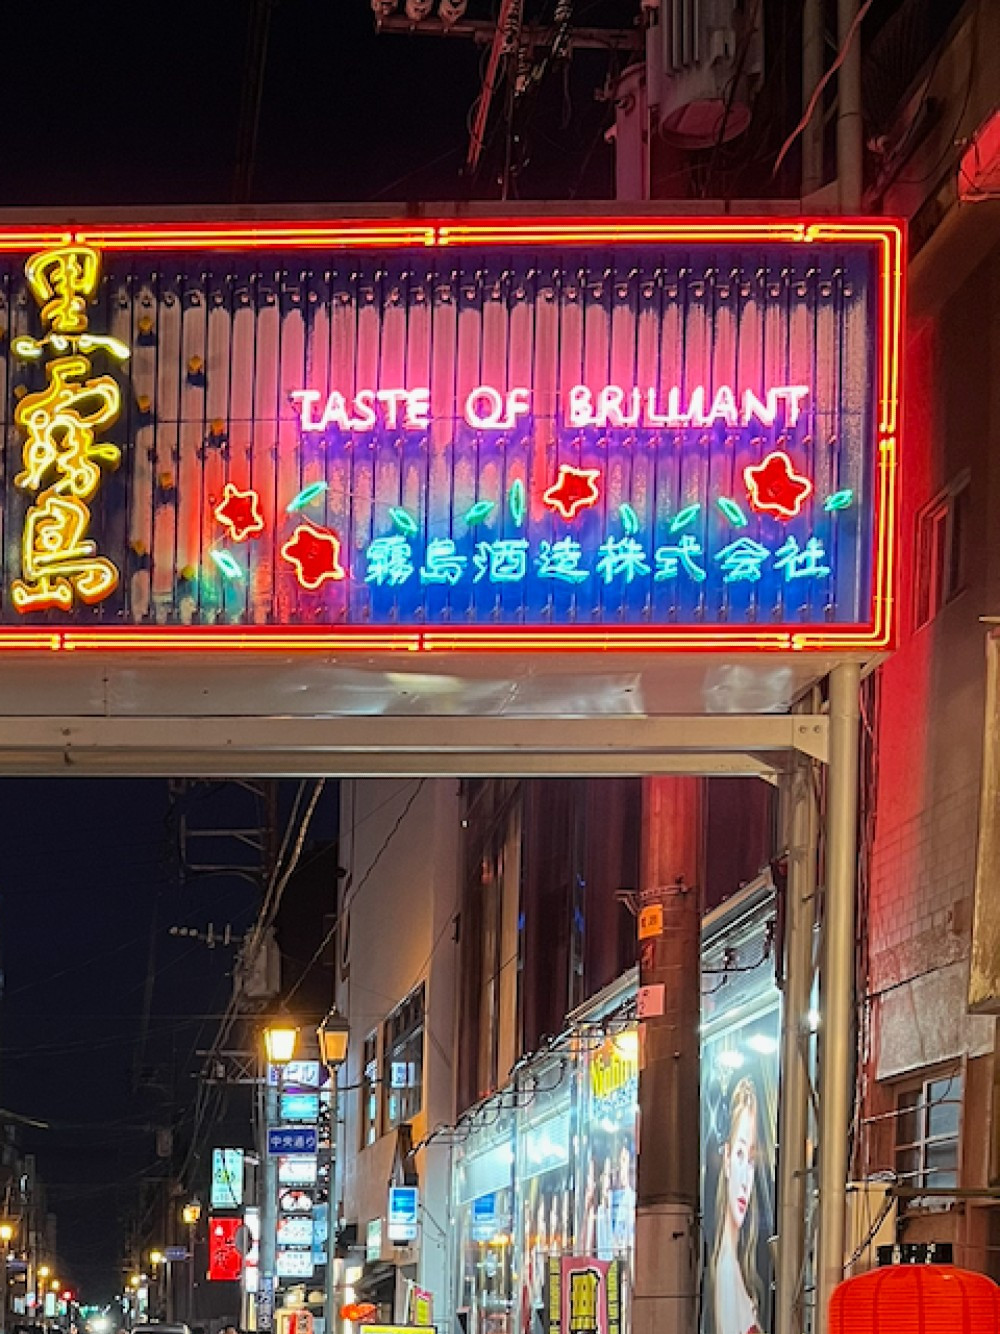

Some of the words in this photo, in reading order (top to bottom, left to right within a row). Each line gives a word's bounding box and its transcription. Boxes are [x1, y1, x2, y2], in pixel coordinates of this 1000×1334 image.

[289, 387, 431, 431] TASTE
[464, 385, 531, 430] OF
[568, 385, 809, 430] BRILLIANT
[365, 535, 832, 584] 霧島酒造株式会社
[270, 1135, 316, 1149] 中央通り
